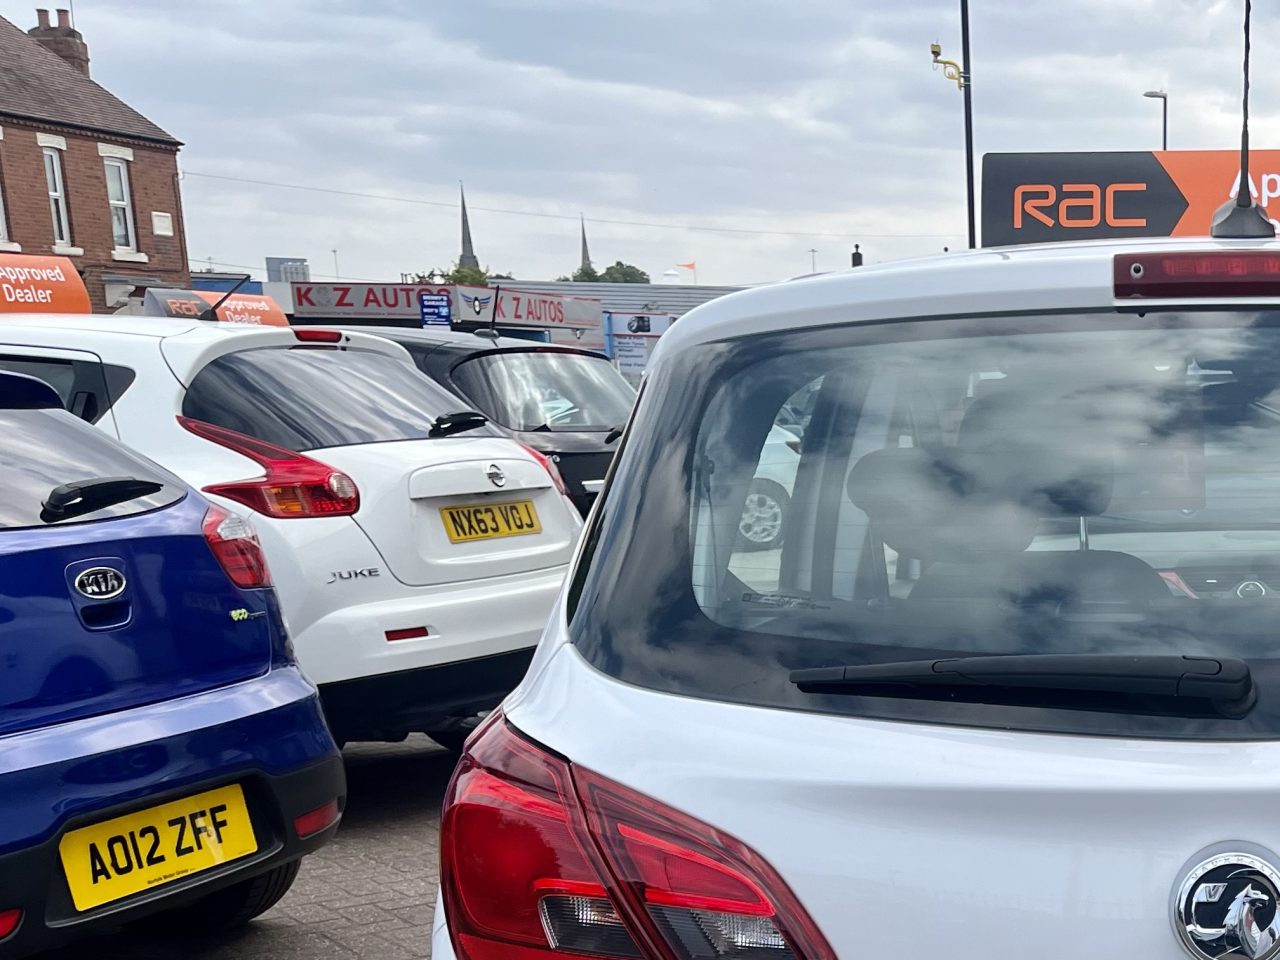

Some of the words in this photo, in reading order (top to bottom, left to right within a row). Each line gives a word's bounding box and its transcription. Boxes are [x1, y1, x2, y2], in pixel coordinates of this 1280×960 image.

[0, 265, 65, 284] Approved
[3, 285, 52, 303] Dealer
[513, 297, 522, 320] Z
[527, 298, 564, 323] AUTOS
[448, 508, 499, 537] NX63
[500, 504, 534, 531] VGJ
[83, 571, 118, 594] KIA
[326, 567, 380, 584] JUKE
[88, 825, 166, 884] AO12
[167, 804, 227, 858] ZFF
[1190, 854, 1277, 881] VAUXHALL
